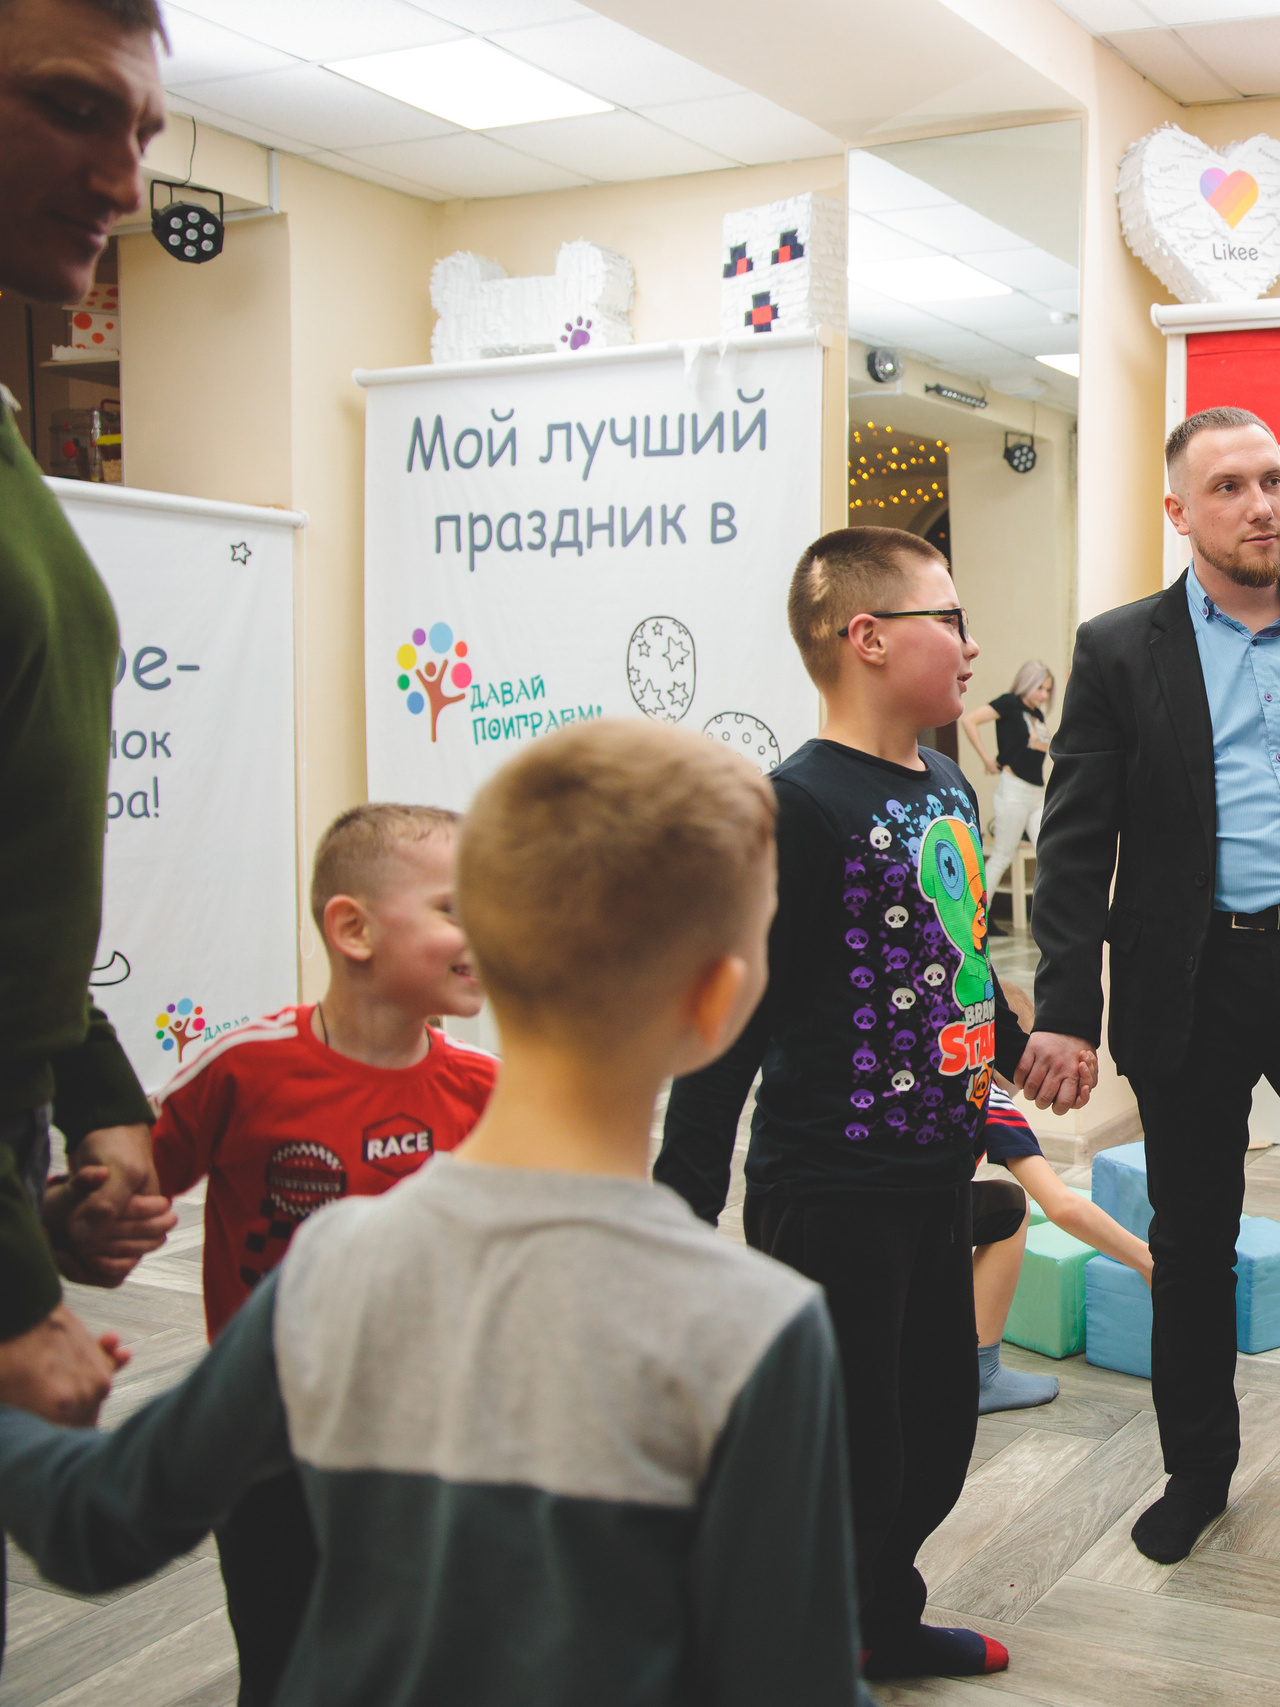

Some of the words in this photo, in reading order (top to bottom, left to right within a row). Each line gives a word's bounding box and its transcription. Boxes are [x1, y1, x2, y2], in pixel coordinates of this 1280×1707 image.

[1212, 243, 1259, 261] Likee
[406, 408, 516, 473] Мой
[539, 387, 767, 482] лучший
[435, 503, 688, 572] праздник
[710, 501, 738, 545] в
[470, 674, 546, 712] ДАВАЙ
[366, 1130, 430, 1161] RACE
